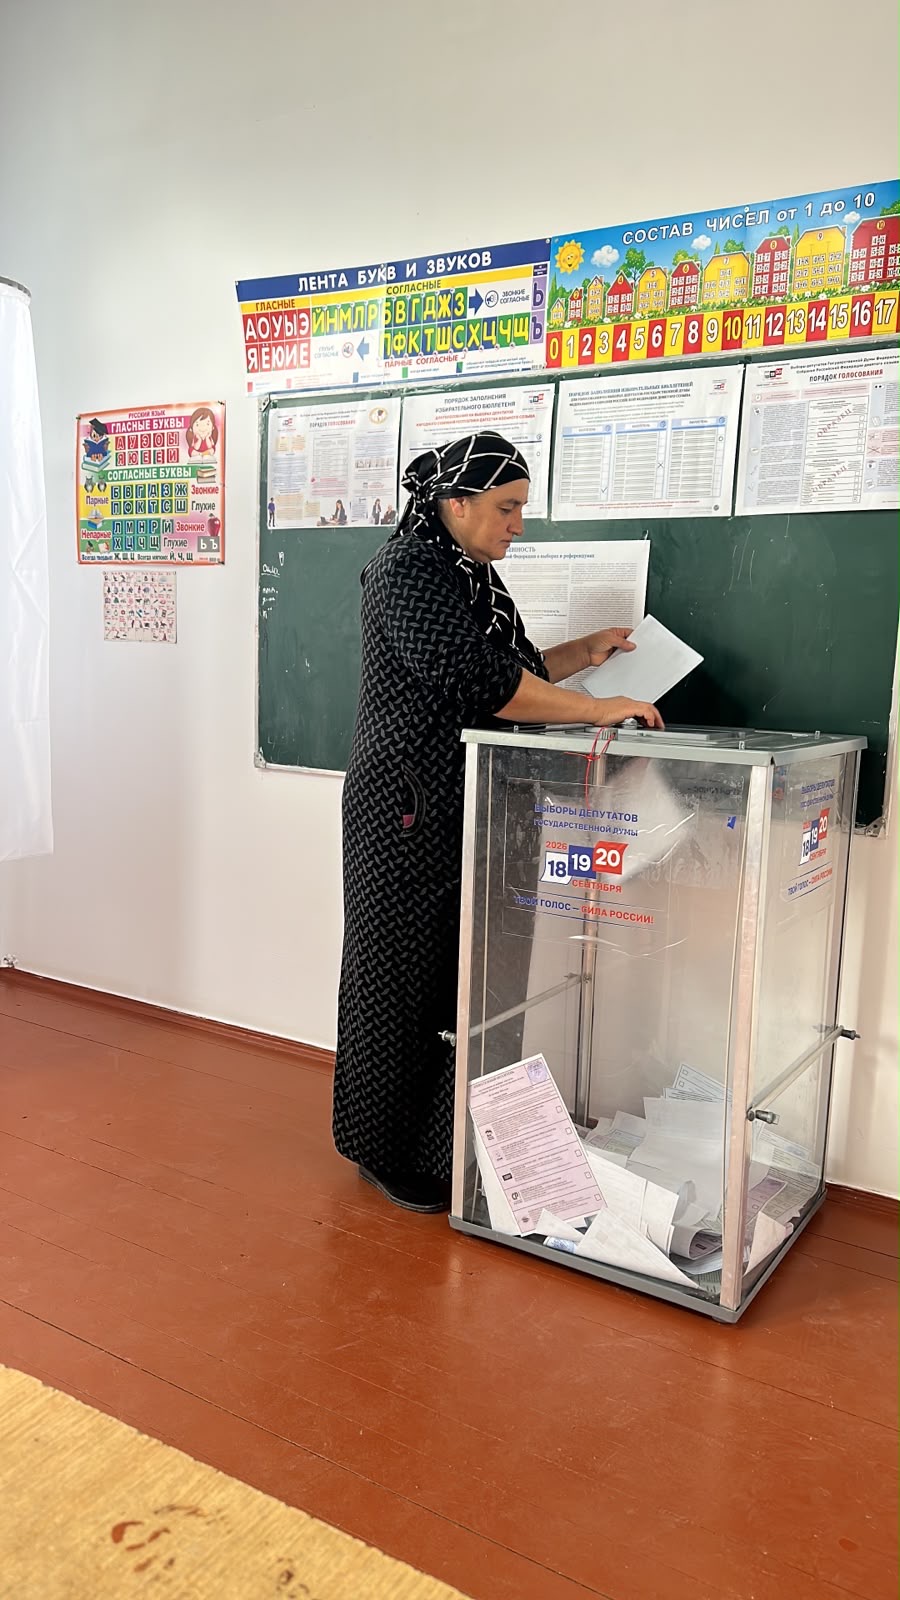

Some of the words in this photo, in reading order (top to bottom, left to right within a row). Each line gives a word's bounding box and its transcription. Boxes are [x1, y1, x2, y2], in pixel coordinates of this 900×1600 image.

[623, 223, 693, 245] СОСТАВ
[706, 210, 769, 232] ЧИСЕЛ
[777, 208, 798, 222] от
[804, 204, 812, 216] 1
[820, 200, 846, 216] до
[854, 192, 876, 208] 10
[298, 272, 348, 293] ЛЕНТА
[358, 265, 396, 286] БУКВ
[406, 262, 416, 278] И
[427, 251, 492, 275] ЗВУКОВ
[386, 280, 441, 294] СОГЛАСНЫЕ
[502, 288, 526, 296] ЗВОНКИЕ
[532, 282, 544, 306] Ь
[256, 299, 296, 312] ГЛАСНЫЕ
[500, 294, 530, 304] СОГЛАСНЫЕ
[531, 316, 543, 340] Ъ
[550, 338, 559, 360] 0
[566, 335, 574, 358] 1
[582, 334, 592, 356] 2
[598, 331, 610, 354] 3
[616, 330, 627, 352] 4
[634, 327, 645, 350] 5
[652, 324, 662, 348] 6
[670, 322, 682, 346] 7
[688, 320, 699, 344] 8
[706, 318, 718, 342] 9
[724, 316, 742, 340] 10
[745, 314, 761, 339] 11
[766, 312, 784, 336] 12
[786, 308, 804, 334] 13
[808, 306, 826, 332] 14
[830, 304, 848, 328] 15
[852, 300, 870, 327] 16
[875, 298, 896, 324] 17
[384, 358, 413, 368] ПАРНЫЕ
[416, 354, 459, 365] СОГЛАСНЫЕ
[810, 372, 838, 382] ПОРЯДОК
[838, 369, 884, 380] ГОЛОСОВАНИЯ
[444, 396, 468, 404] ПОРЯДОК
[470, 394, 506, 402] ЗАПОЛНЕНИЯ
[128, 411, 150, 419] РУССКИЙ
[436, 404, 482, 413] ИЗБИРАТЕЛЬНОГО
[112, 420, 150, 433] ГЛАСНЫЕ
[152, 417, 184, 429] БУКВЫ
[116, 438, 125, 450] А
[128, 436, 137, 448] У
[142, 435, 150, 447] Э
[156, 434, 164, 446] О
[168, 432, 178, 445] Ы
[117, 454, 124, 466] Я
[128, 452, 138, 464] Ю
[168, 449, 178, 462] И
[107, 469, 157, 482] СОГЛАСНЫЕ
[159, 467, 192, 479] БУКВЫ
[112, 487, 120, 498] Б
[125, 486, 132, 498] В
[138, 486, 144, 497] Г
[149, 484, 158, 498] Д
[162, 485, 170, 496] З
[175, 484, 186, 495] Ж
[191, 484, 219, 495] Звонкие
[86, 496, 109, 506] Парные
[112, 502, 120, 514] П
[124, 502, 132, 513] Ф
[138, 501, 146, 512] К
[150, 500, 158, 512] Т
[162, 500, 170, 511] С
[176, 500, 186, 511] Ш
[191, 500, 216, 512] Глухие
[114, 522, 121, 534] Л
[126, 522, 134, 533] М
[138, 521, 146, 532] Н
[151, 520, 158, 532] Р
[164, 520, 172, 532] Й
[176, 522, 205, 532] Звонкие
[82, 530, 112, 540] Непарные
[114, 538, 121, 550] Х
[126, 537, 134, 550] Ц
[139, 536, 146, 548] Ч
[150, 536, 159, 548] Щ
[163, 537, 188, 549] Глухие
[200, 539, 206, 548] Ь
[210, 538, 218, 548] Ъ
[186, 552, 193, 561] Щ
[534, 804, 577, 816] ВЫБОРЫ
[578, 808, 638, 822] ДЕПУТАТОВ
[534, 819, 612, 834] ГОСУДАРСТВЕННОЙ
[612, 828, 638, 837] ДУМЫ
[819, 816, 828, 832] 20
[810, 827, 818, 844] 19
[546, 840, 568, 850] 2026
[802, 840, 810, 857] 18
[548, 860, 566, 877] 18
[571, 854, 591, 871] 19
[596, 848, 620, 866] 20
[572, 880, 622, 893] СЕНТЯБРЯ
[514, 895, 538, 906] ТВОЙ
[540, 899, 571, 910] ГОЛОС
[582, 905, 608, 917] СИЛА
[610, 910, 654, 924] РОССИИ!
